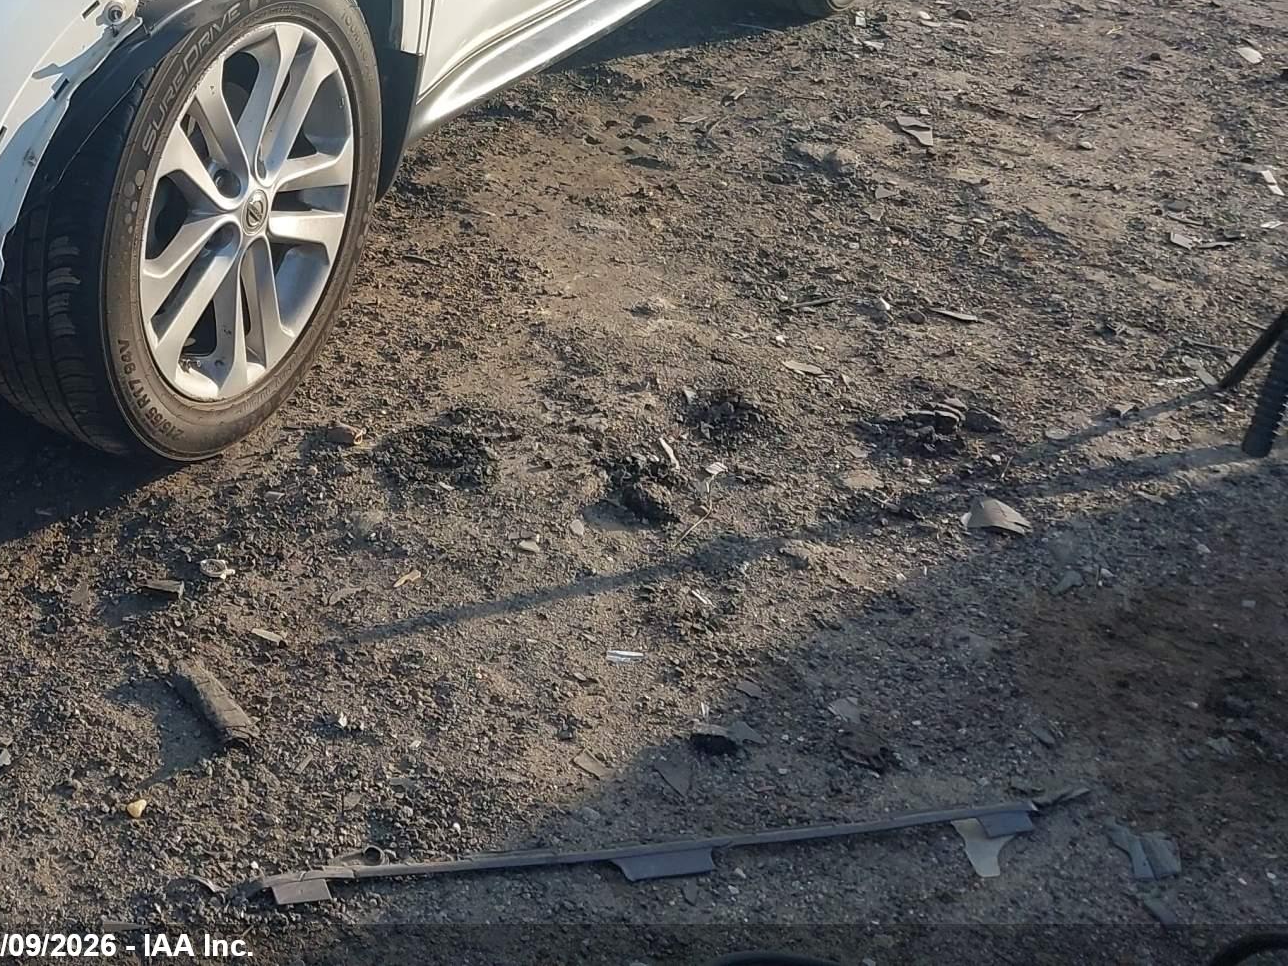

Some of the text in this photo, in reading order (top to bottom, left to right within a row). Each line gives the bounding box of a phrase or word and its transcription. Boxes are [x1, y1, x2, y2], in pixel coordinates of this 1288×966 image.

[142, 2, 241, 155] SUREDRIVE
[128, 378, 151, 409] R17
[145, 407, 185, 441] 215/55
